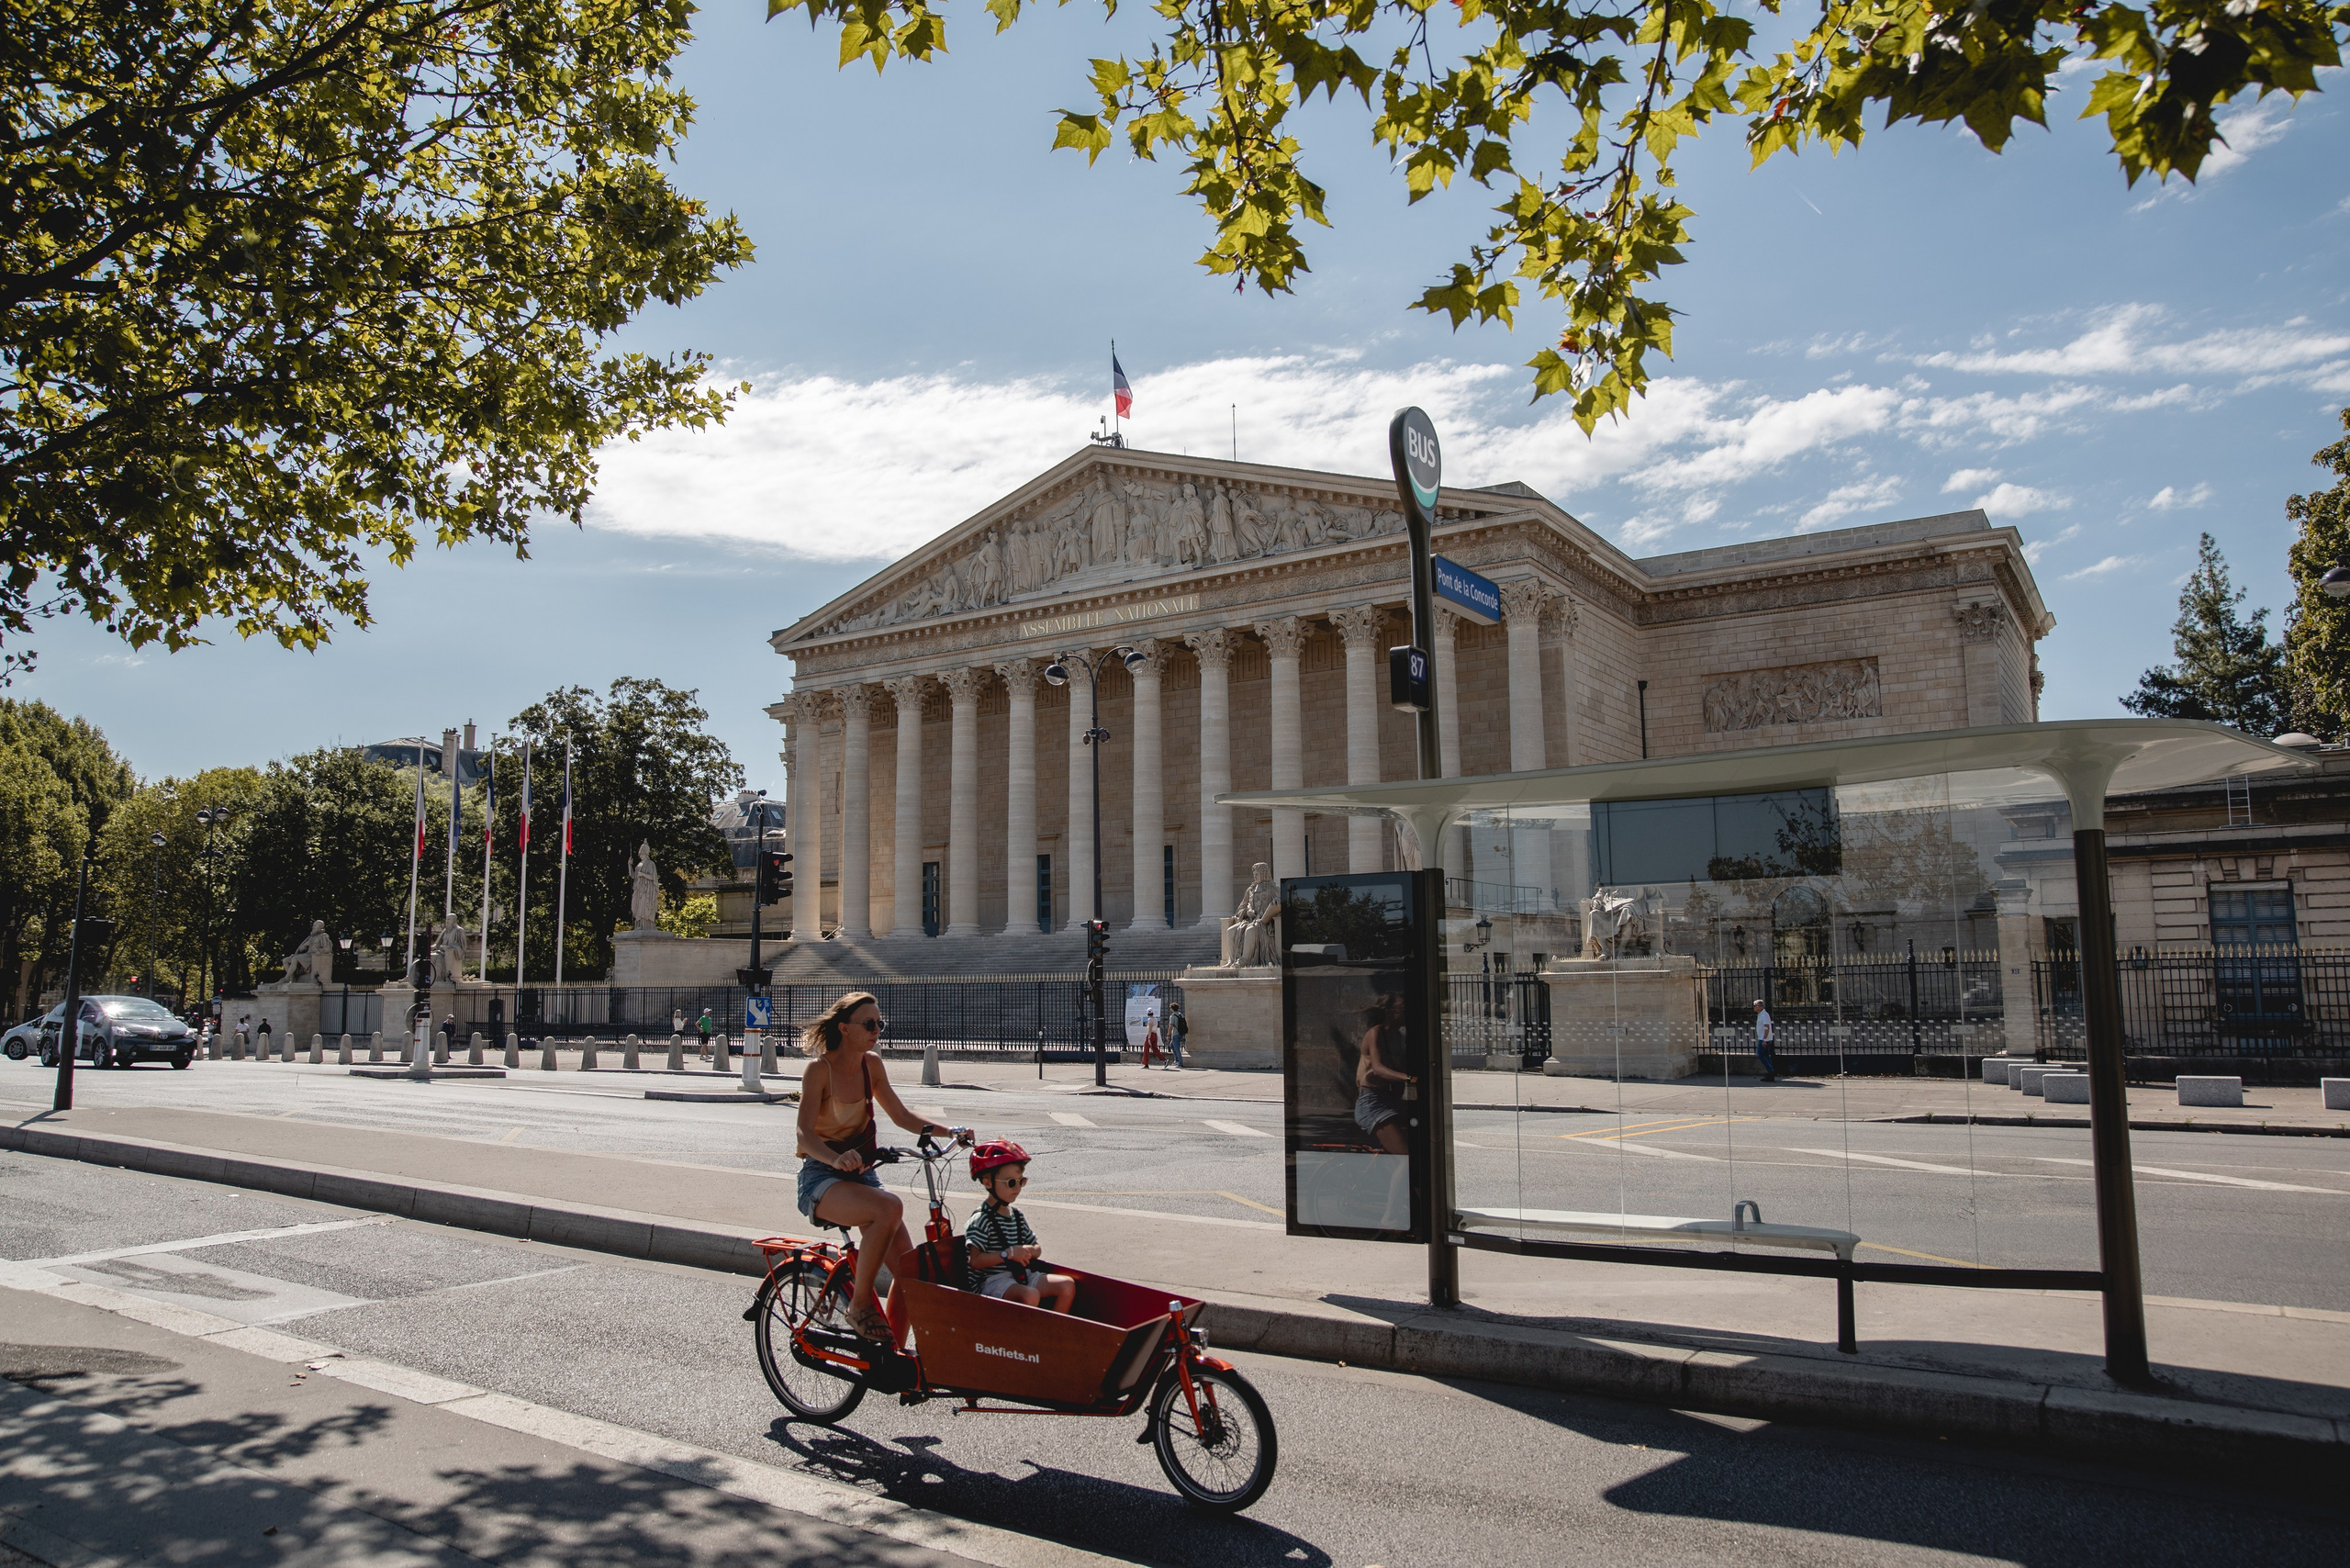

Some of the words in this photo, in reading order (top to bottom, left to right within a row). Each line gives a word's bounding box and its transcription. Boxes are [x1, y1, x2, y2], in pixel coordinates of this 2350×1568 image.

[1408, 426, 1436, 468] BUS
[1438, 567, 1453, 589] Pont
[1454, 576, 1462, 594] de
[1462, 579, 1470, 597] la
[1470, 584, 1498, 610] Concorde
[1020, 610, 1104, 639] ASSEMBLÉE
[1114, 595, 1200, 623] NATIONALE
[1410, 655, 1424, 678] 87
[975, 1343, 1040, 1364] Bakfiets.nl
